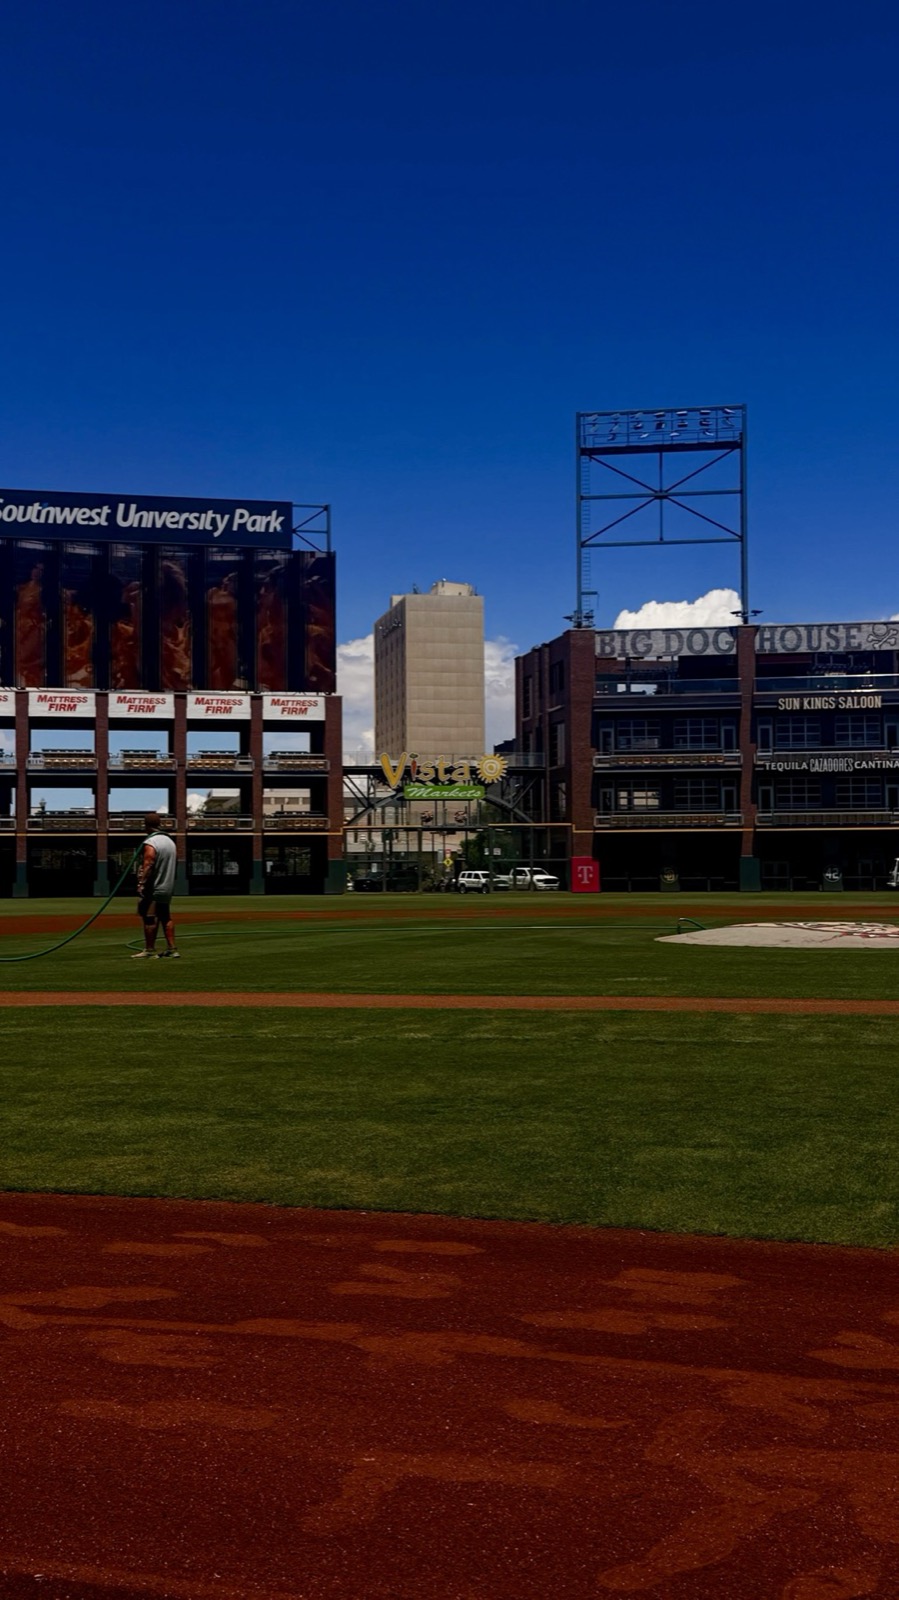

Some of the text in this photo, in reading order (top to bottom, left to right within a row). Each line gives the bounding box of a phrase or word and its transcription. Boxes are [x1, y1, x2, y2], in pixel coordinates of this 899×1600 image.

[0, 498, 285, 538] outhwest University Park
[597, 625, 862, 657] BIG DOG HOUSE
[37, 694, 88, 703] MATTRESS
[116, 695, 167, 704] MATTRESS
[195, 697, 243, 706] MATTRESS
[270, 698, 319, 707] MATTRESS
[778, 695, 883, 711] SUN KINGS SALOON
[48, 703, 77, 711] FIRM
[127, 704, 156, 712] FIRM
[205, 705, 233, 714] FIRM
[281, 707, 308, 715] FIRM
[765, 757, 899, 773] TEQUILA CAZADORES CANTINA
[380, 752, 471, 790] Vista
[405, 786, 482, 798] Markets
[825, 866, 841, 881] 42
